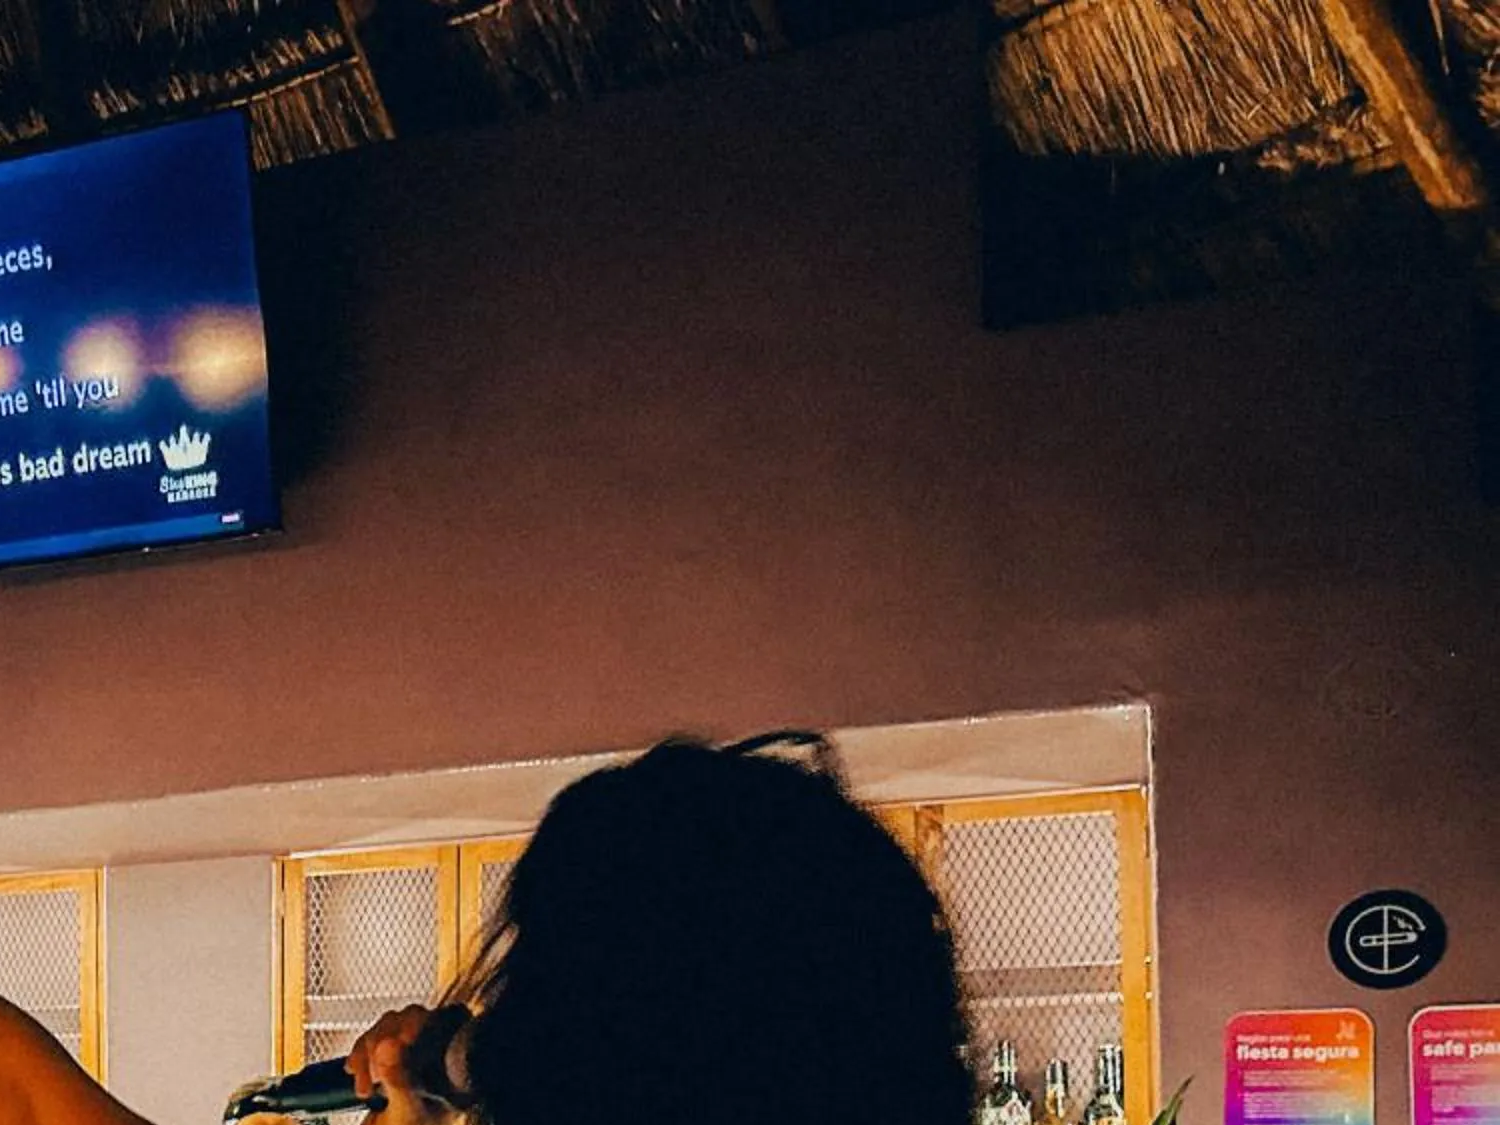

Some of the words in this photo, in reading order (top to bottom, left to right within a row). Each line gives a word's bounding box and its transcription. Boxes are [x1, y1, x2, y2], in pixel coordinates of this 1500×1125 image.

[35, 373, 66, 409] 'til
[73, 375, 119, 409] you
[18, 447, 65, 483] bad
[73, 439, 151, 474] dream
[1237, 1044, 1289, 1060] fiesta
[1292, 1046, 1359, 1063] segura
[1423, 1040, 1465, 1057] safe
